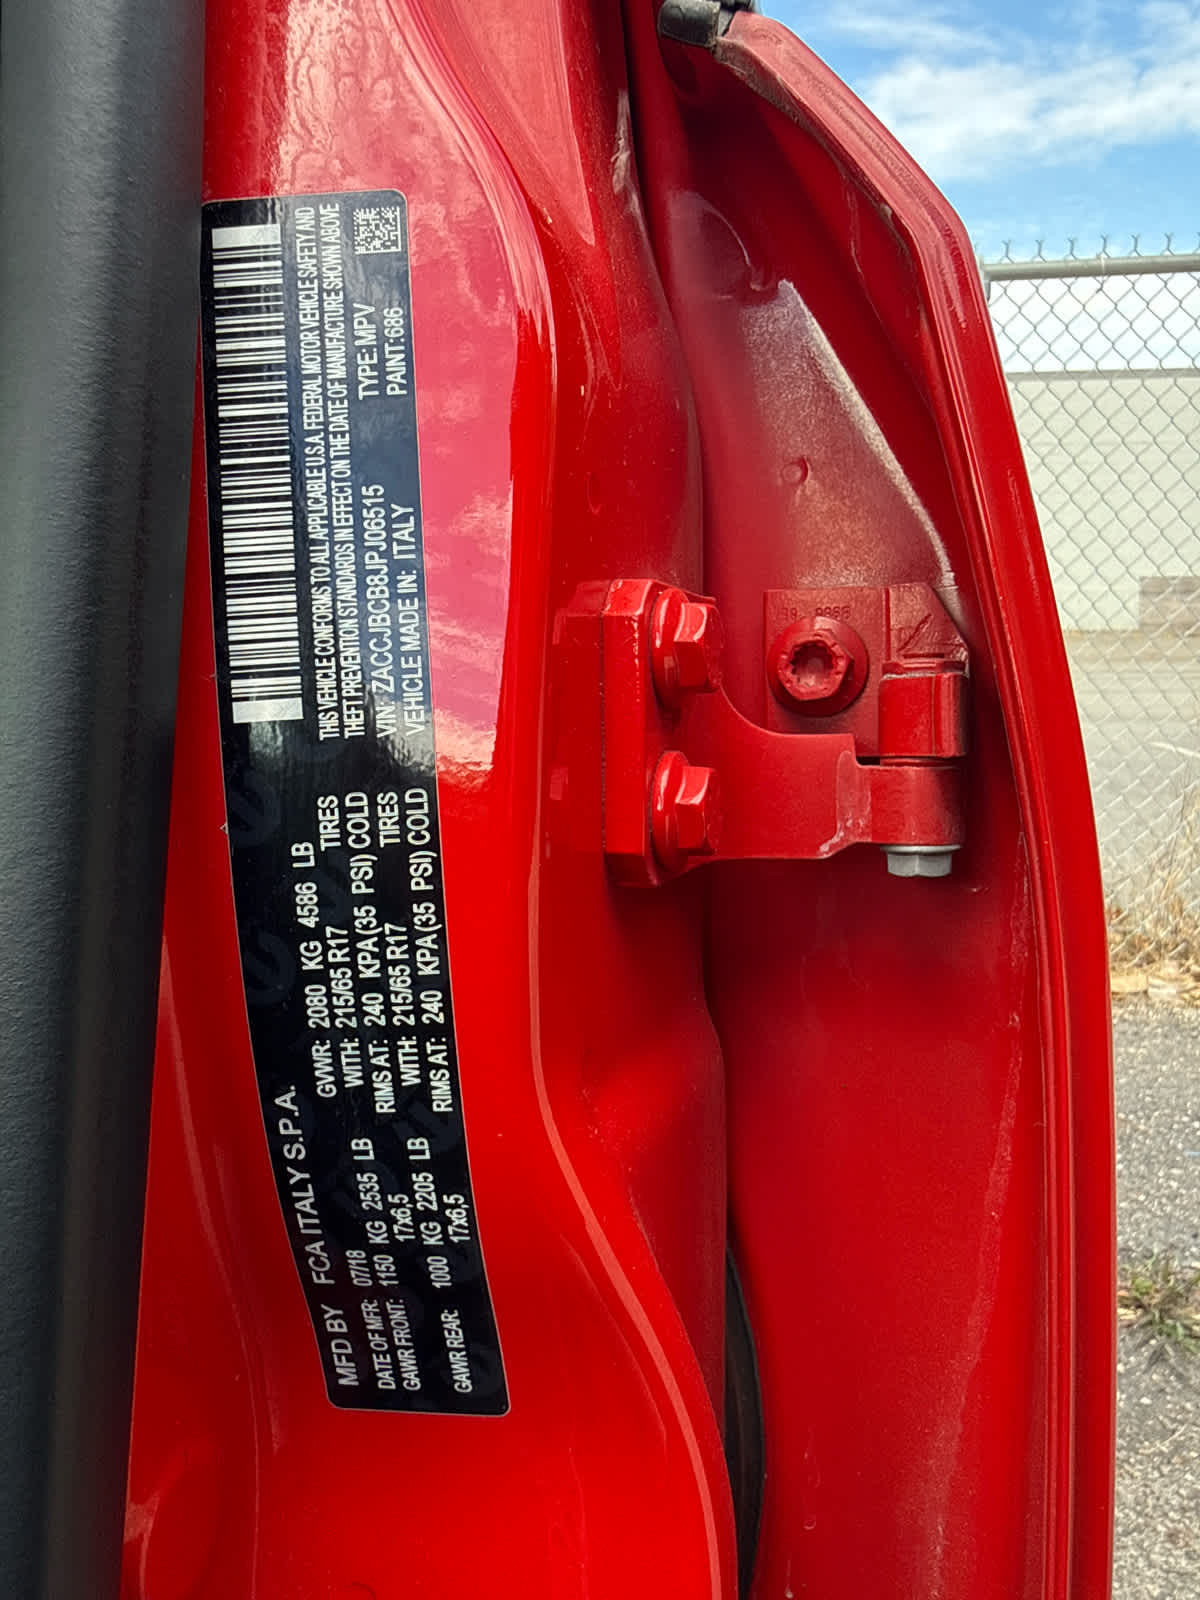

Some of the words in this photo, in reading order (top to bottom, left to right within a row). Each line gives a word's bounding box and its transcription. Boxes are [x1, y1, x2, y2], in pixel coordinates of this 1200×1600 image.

[295, 207, 315, 231] AND
[320, 203, 340, 243] ABOVE
[295, 234, 318, 278] SAFETY
[322, 245, 342, 289] SHOWN
[297, 279, 319, 327] VEHICLE
[299, 330, 321, 374] MOTOR
[323, 289, 347, 379] MANUFACTURE
[301, 376, 324, 429] FEDERAL
[327, 380, 347, 397] OF
[327, 399, 348, 431] DATE
[329, 433, 350, 458] THE
[331, 460, 350, 477] ON
[306, 468, 328, 539] APPLICABLE
[332, 480, 353, 526] EFFECT
[334, 528, 355, 541] IN
[391, 503, 416, 560] ITALY
[309, 541, 330, 564] ALL
[310, 566, 331, 584] TO
[335, 543, 358, 616] STANDARDS
[397, 570, 418, 593] IN:
[311, 587, 334, 655] CONFORMS
[398, 599, 421, 651] MADE
[339, 618, 363, 697] PREVENTION
[314, 657, 337, 710] VEHICLE
[401, 656, 426, 735] VEHICLE
[318, 711, 340, 740] THIS
[343, 698, 365, 738] THEFT
[376, 701, 397, 737] VIN:
[317, 795, 341, 851] TIRES
[345, 792, 370, 848] COLD
[377, 791, 400, 847] TIRES
[405, 788, 430, 845] COLD
[292, 842, 315, 867] LB
[351, 854, 377, 893] PSI)
[409, 851, 436, 890] PSI)
[295, 882, 319, 928] 4586
[300, 940, 323, 970] KG
[326, 925, 350, 962] R17
[385, 923, 408, 959] R17
[305, 985, 330, 1029] 2080
[328, 968, 357, 1028] 215/65
[362, 993, 386, 1026] 240
[387, 965, 415, 1025] 215/65
[420, 990, 444, 1024] 240
[313, 1040, 337, 1097] GVWR:
[340, 1038, 364, 1087] WITH:
[369, 1039, 390, 1068] AT:
[398, 1036, 421, 1086] WITH:
[426, 1037, 448, 1066] AT:
[372, 1070, 395, 1113] RIMS
[431, 1069, 453, 1112] RIMS
[274, 1085, 306, 1160] S.P.A.
[351, 1138, 374, 1160] LB
[407, 1137, 430, 1160] LB
[287, 1167, 322, 1234] ITALY
[357, 1172, 382, 1210] 2535
[412, 1172, 437, 1211] 2205
[366, 1220, 389, 1244] KG
[420, 1221, 444, 1245] KG
[305, 1241, 335, 1285] FCA
[346, 1250, 373, 1286] 07/18
[373, 1255, 399, 1287] 1150
[428, 1256, 452, 1288] 1000
[321, 1304, 348, 1332] BY
[361, 1299, 384, 1330] MFR:
[388, 1299, 413, 1345] FRONT:
[441, 1310, 464, 1348] REAR:
[370, 1332, 389, 1350] OF
[330, 1339, 359, 1385] MFD
[373, 1354, 396, 1389] DATE
[396, 1348, 422, 1391] GAWR
[449, 1351, 472, 1393] GAWR
